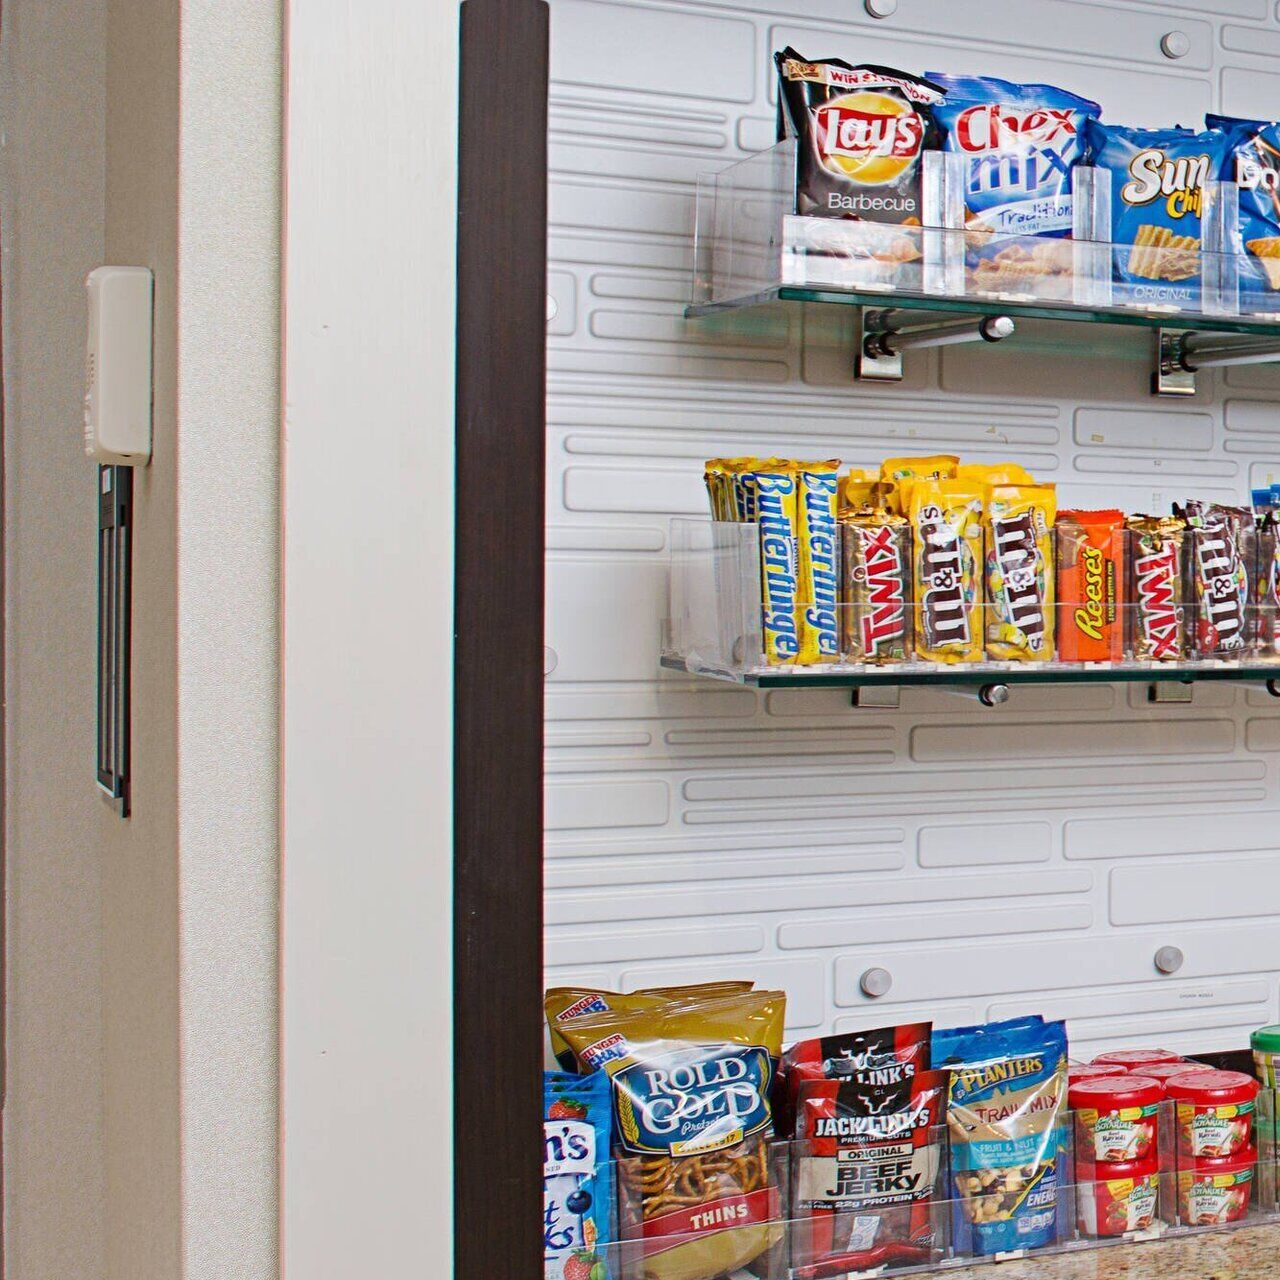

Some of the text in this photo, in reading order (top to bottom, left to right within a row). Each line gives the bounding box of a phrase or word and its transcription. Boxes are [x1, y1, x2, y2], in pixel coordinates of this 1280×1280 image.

[956, 101, 1076, 153] Chex
[1121, 149, 1211, 205] Sun
[828, 192, 916, 215] Barbecue
[1166, 185, 1212, 219] Chip
[1133, 287, 1192, 301] ORIGINAL
[756, 472, 799, 659] Butterfinge
[802, 472, 838, 656] Butterfinge
[861, 526, 905, 657] TWIX
[1074, 545, 1103, 640] Reese's
[1135, 541, 1180, 659] TWIX
[558, 993, 600, 1021] HUNGER
[583, 1033, 624, 1061] HUNGER
[645, 1056, 749, 1096] ROLD
[857, 1063, 915, 1086] LINK'S
[961, 1058, 1044, 1092] PLANTERS
[641, 1081, 760, 1134] GOLD
[1030, 1095, 1059, 1114] MIX
[847, 1146, 905, 1159] ORIGINAL
[826, 1173, 922, 1197] JERKY
[837, 1161, 912, 1182] BEEF
[863, 1193, 913, 1206] PROTEIN
[690, 1202, 749, 1231] THINS
